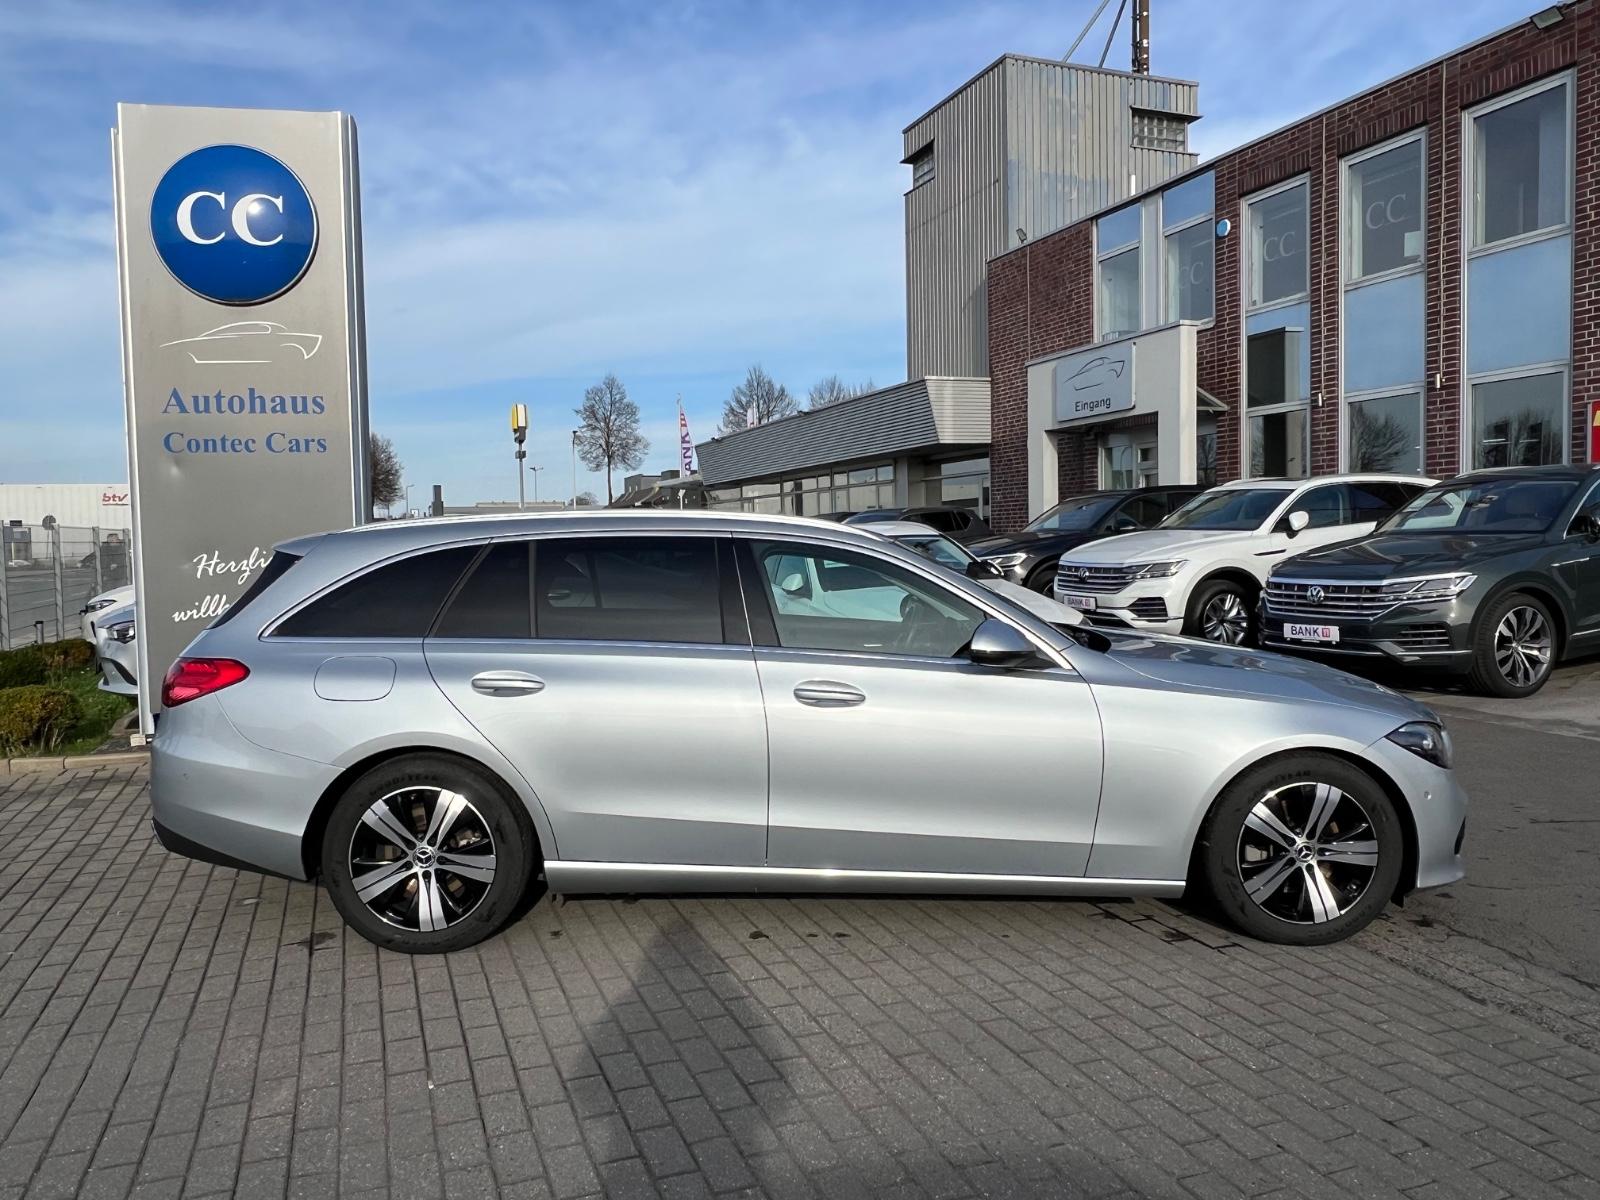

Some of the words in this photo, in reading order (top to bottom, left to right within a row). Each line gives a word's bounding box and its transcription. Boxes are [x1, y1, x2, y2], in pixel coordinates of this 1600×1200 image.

[176, 191, 283, 246] CC
[162, 387, 325, 415] Autohaus
[1074, 397, 1111, 412] Eingang
[163, 432, 257, 454] Contec
[265, 432, 328, 454] Cars
[102, 492, 128, 502] btv
[1290, 625, 1320, 638] BANK
